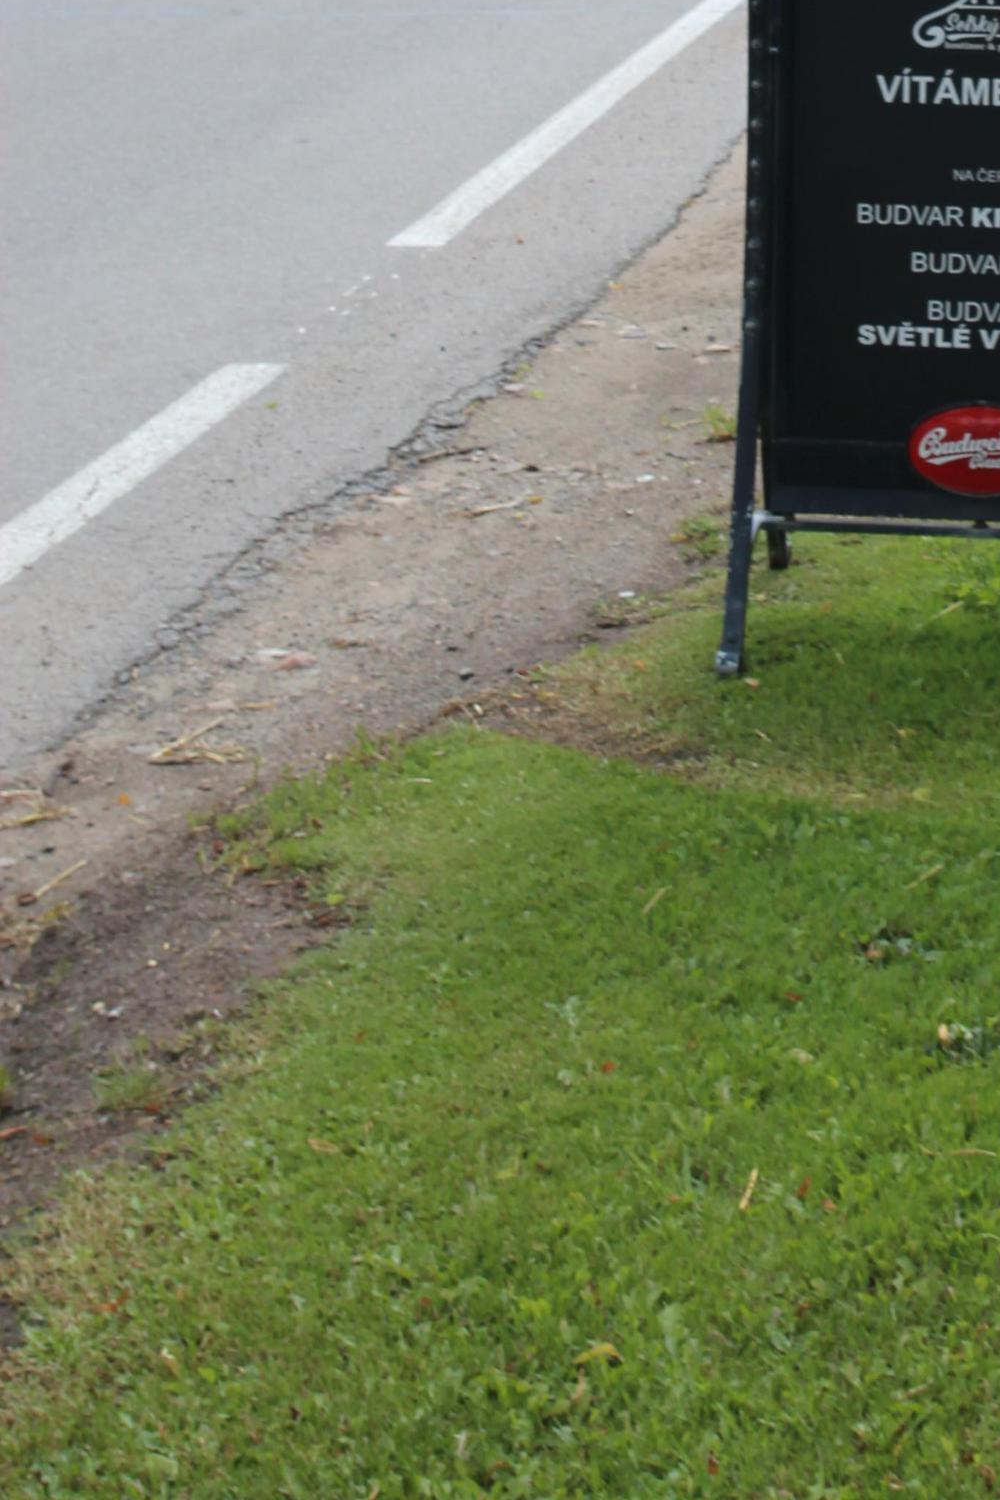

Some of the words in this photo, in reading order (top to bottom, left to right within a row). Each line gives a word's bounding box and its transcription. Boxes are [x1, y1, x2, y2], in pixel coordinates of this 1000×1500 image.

[952, 168, 975, 182] NA
[856, 202, 965, 228] BUDVAR
[857, 323, 972, 349] SVĚTLÉ
